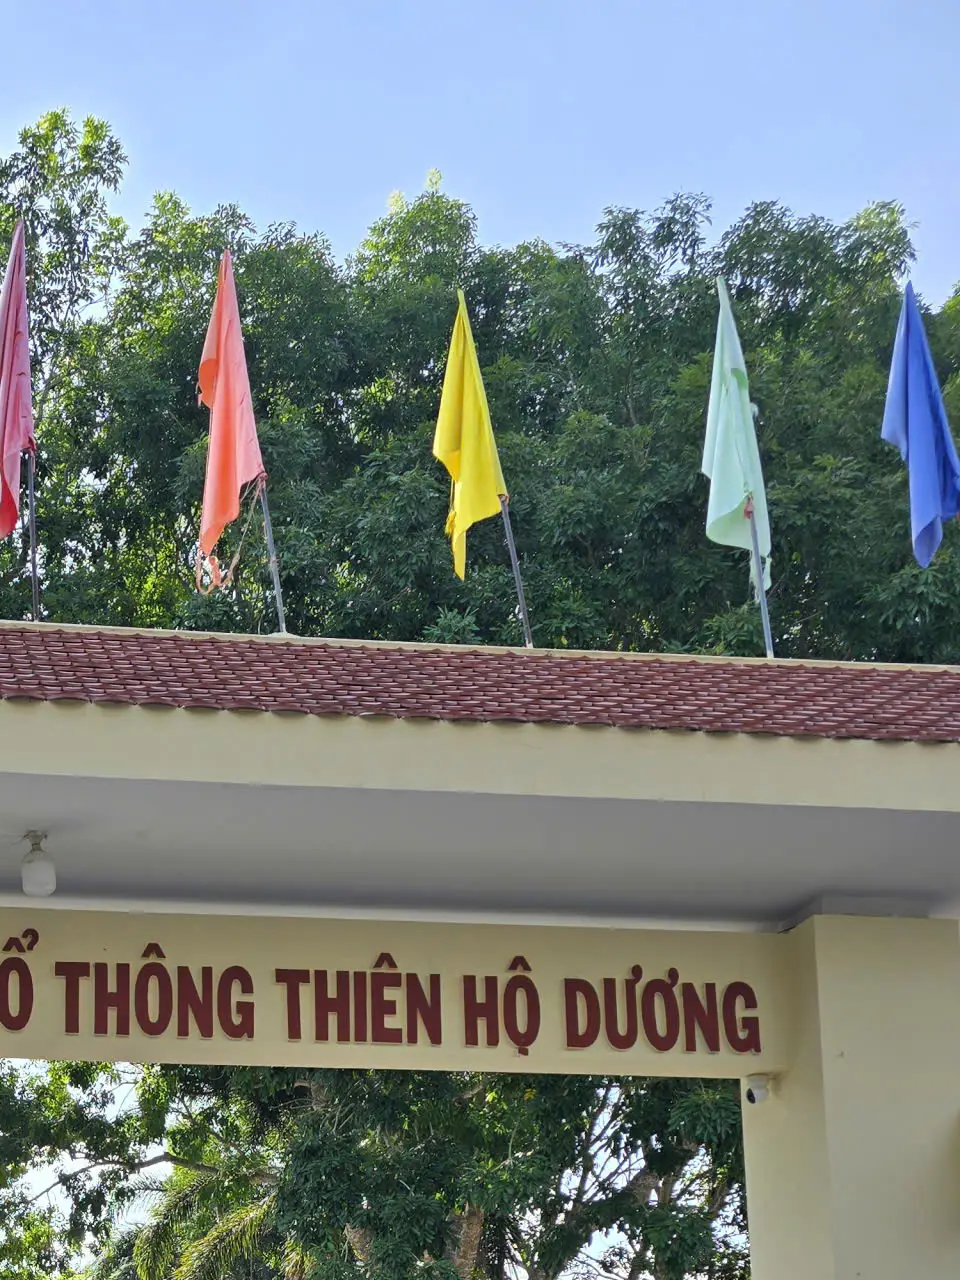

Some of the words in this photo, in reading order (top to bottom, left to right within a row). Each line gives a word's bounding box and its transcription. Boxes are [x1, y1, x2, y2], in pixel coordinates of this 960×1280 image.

[54, 942, 255, 1040] THÔNG
[274, 952, 442, 1046] THIÊN
[463, 955, 541, 1056] HỘ
[563, 964, 762, 1055] DƯƠNG
